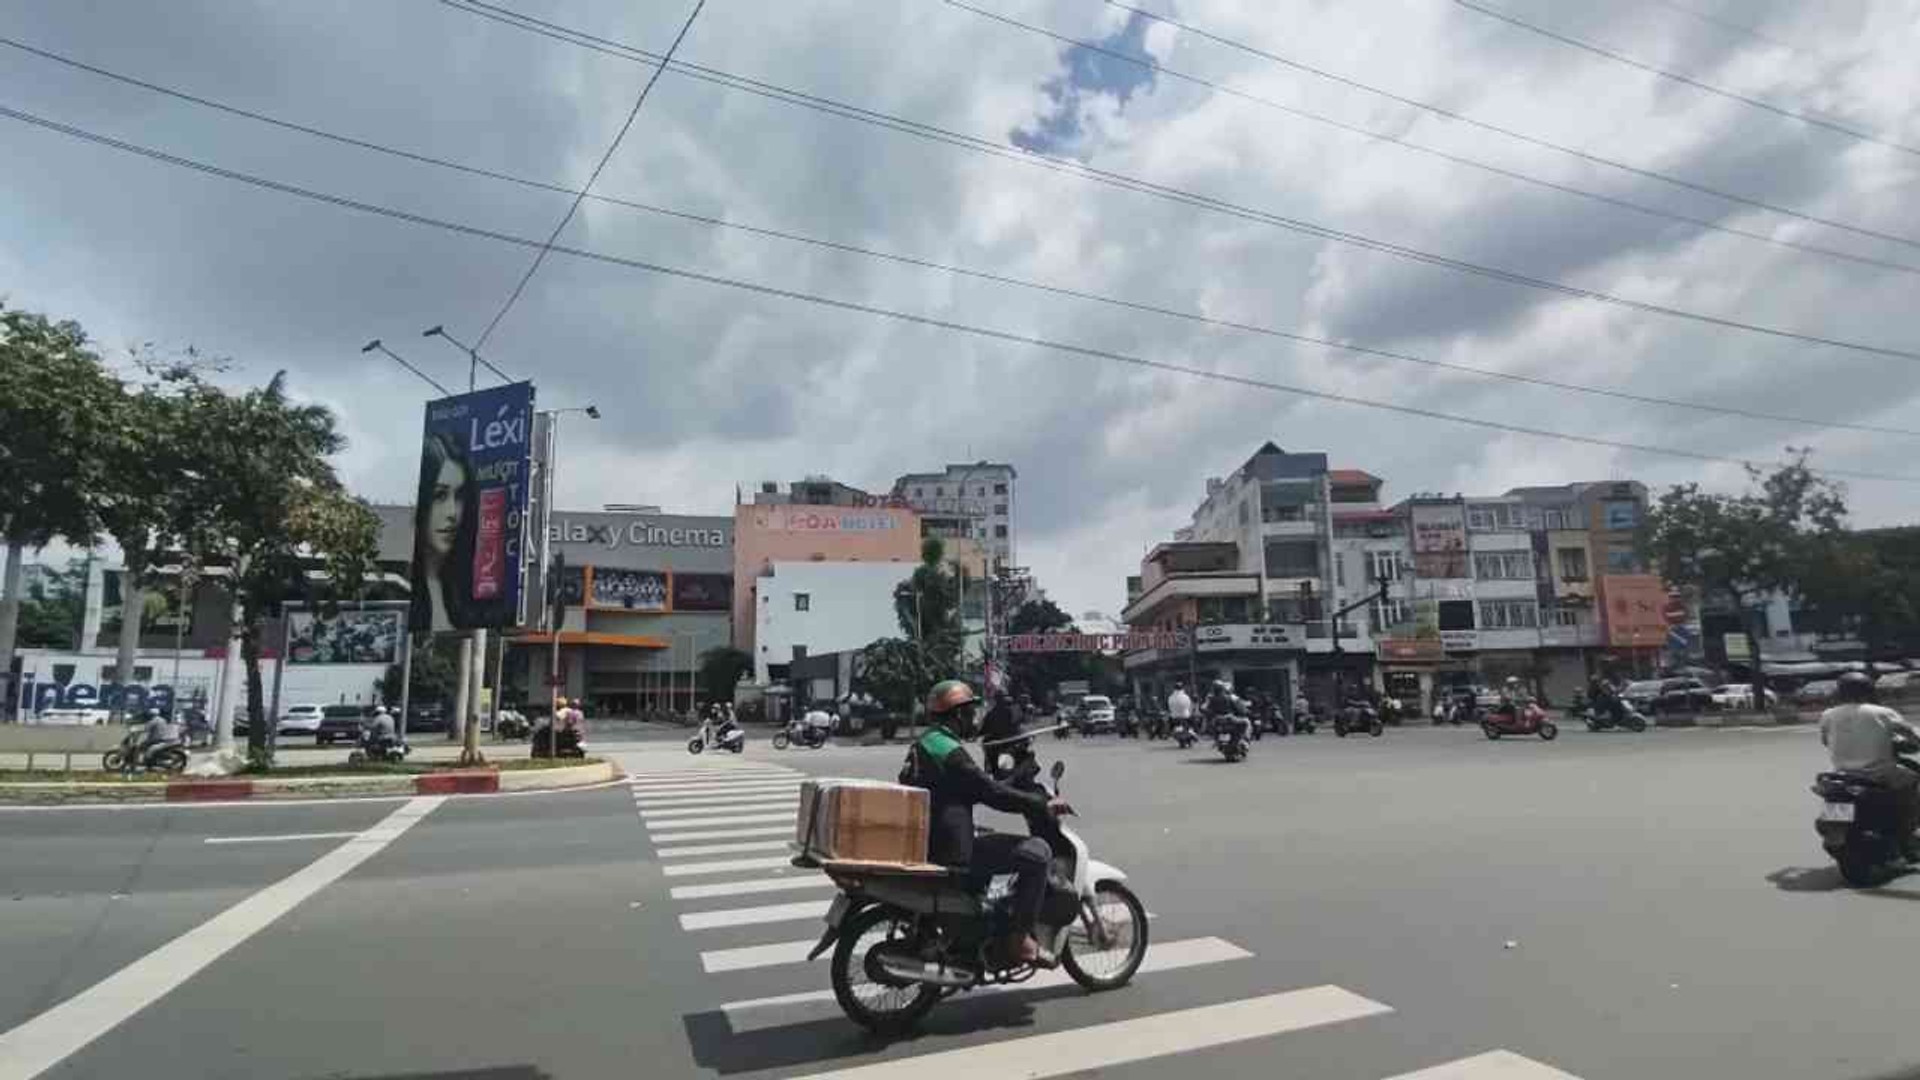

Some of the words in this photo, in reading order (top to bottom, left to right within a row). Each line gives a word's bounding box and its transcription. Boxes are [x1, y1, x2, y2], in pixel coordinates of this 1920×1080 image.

[470, 404, 525, 452] Léxi
[550, 518, 624, 550] alaxy
[629, 520, 724, 547] Cinema
[21, 671, 176, 718] inema
